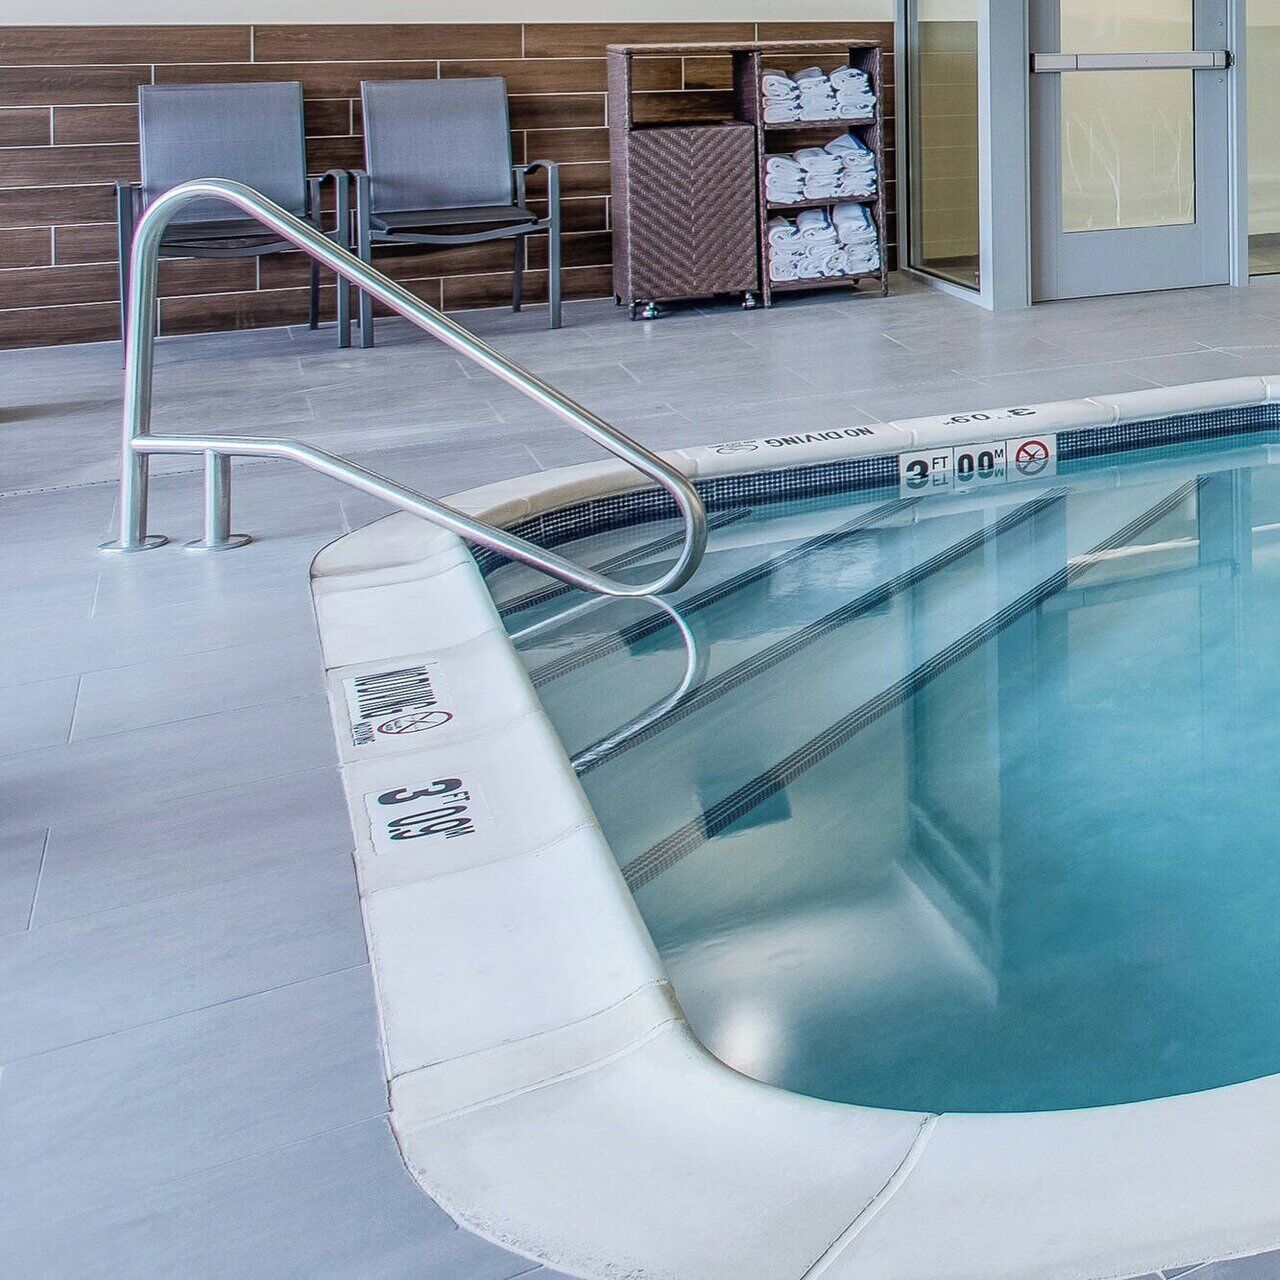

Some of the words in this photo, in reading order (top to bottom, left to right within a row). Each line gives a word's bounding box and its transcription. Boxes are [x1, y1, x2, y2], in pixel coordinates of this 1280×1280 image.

[764, 431, 842, 448] DIVING
[842, 427, 874, 437] NO
[932, 456, 949, 470] FT
[994, 449, 1004, 458] M
[378, 778, 462, 805] 3
